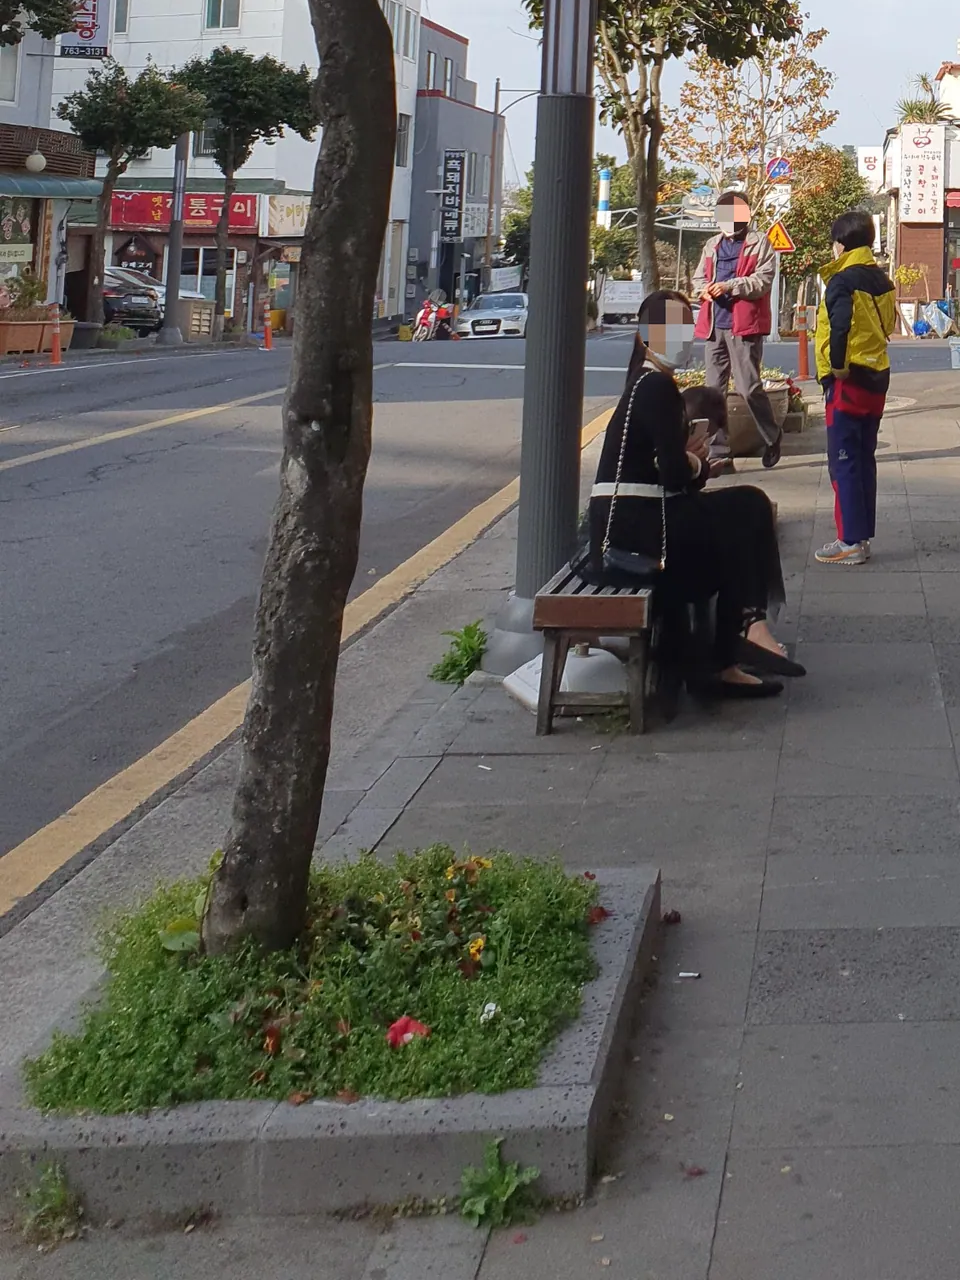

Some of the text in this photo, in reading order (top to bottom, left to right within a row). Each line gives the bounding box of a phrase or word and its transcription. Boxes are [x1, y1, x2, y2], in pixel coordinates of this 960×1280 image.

[64, 47, 104, 56] 763-3131
[864, 156, 878, 171] 땅
[166, 198, 252, 219] 통구이
